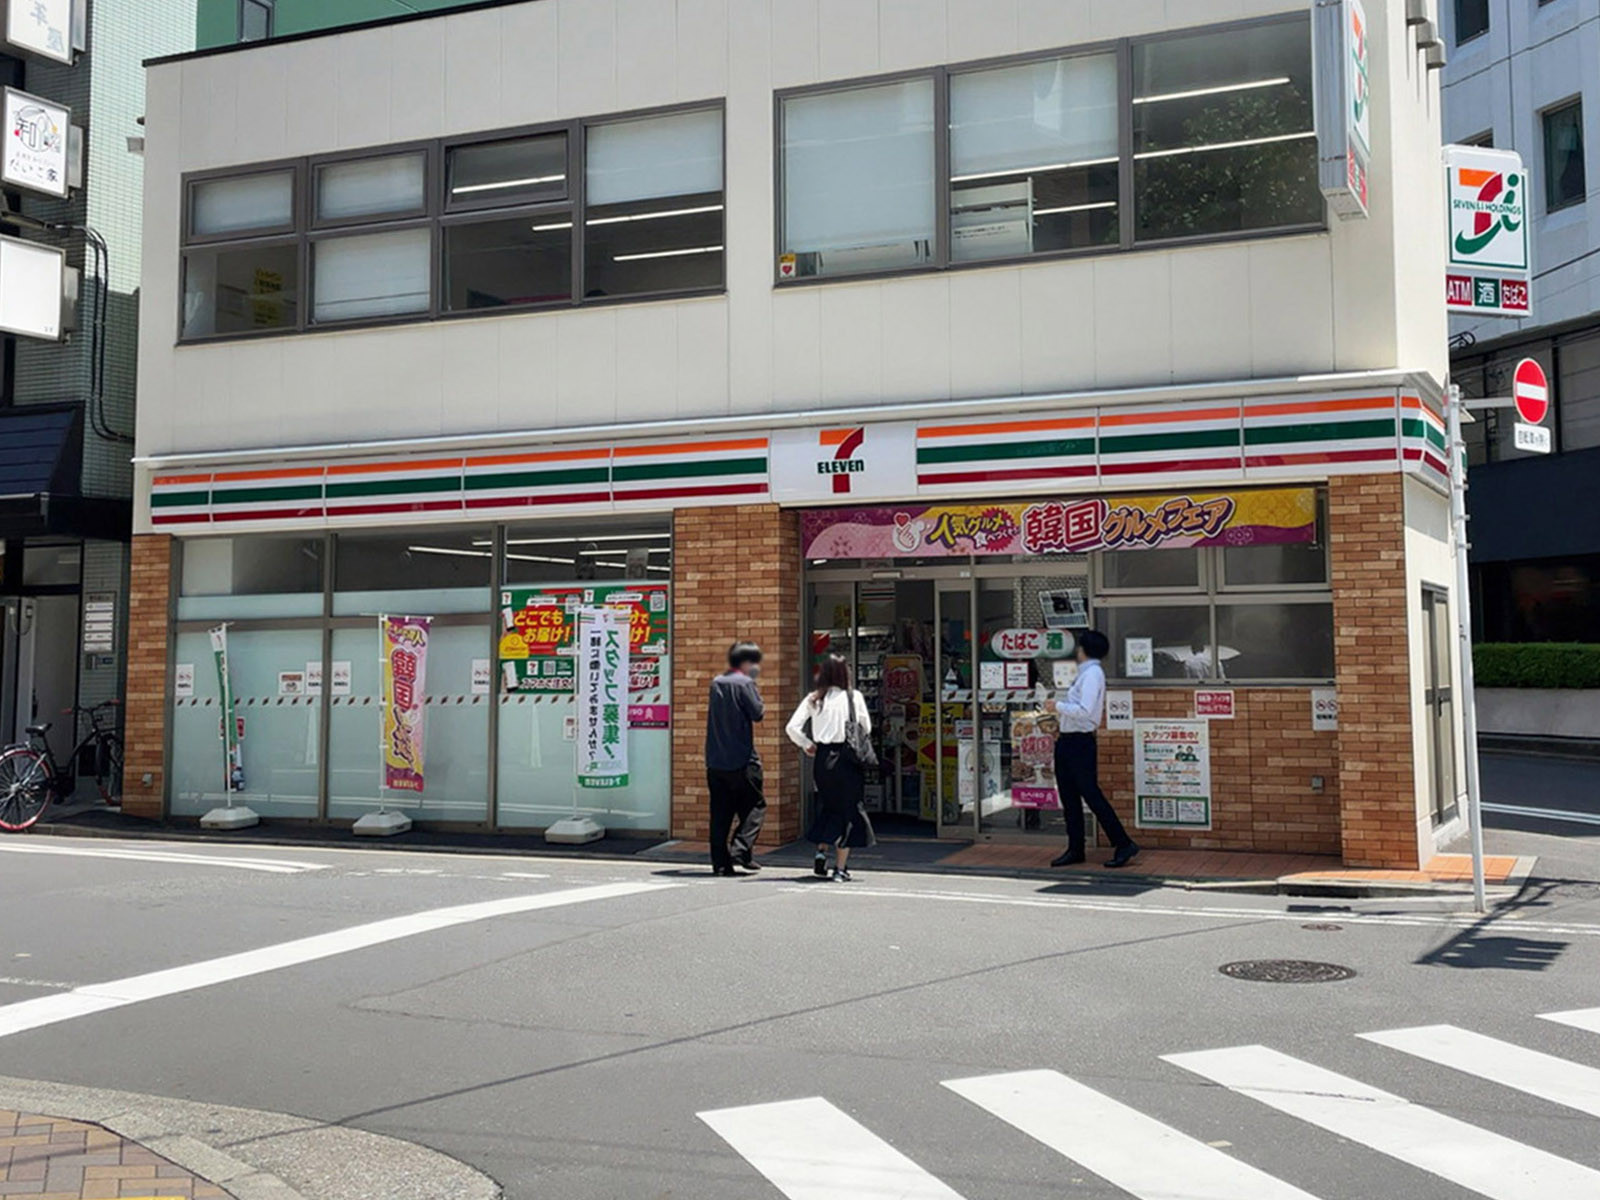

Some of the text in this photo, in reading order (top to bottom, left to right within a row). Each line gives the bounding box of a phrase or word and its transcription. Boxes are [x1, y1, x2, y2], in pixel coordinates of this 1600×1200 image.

[1485, 203, 1522, 216] HOLDINGS
[1447, 279, 1472, 301] ATM
[1478, 281, 1495, 304] 酒
[1501, 284, 1528, 306] たばこ
[514, 610, 564, 626] どこでも
[1001, 632, 1063, 650] たばこ 酒
